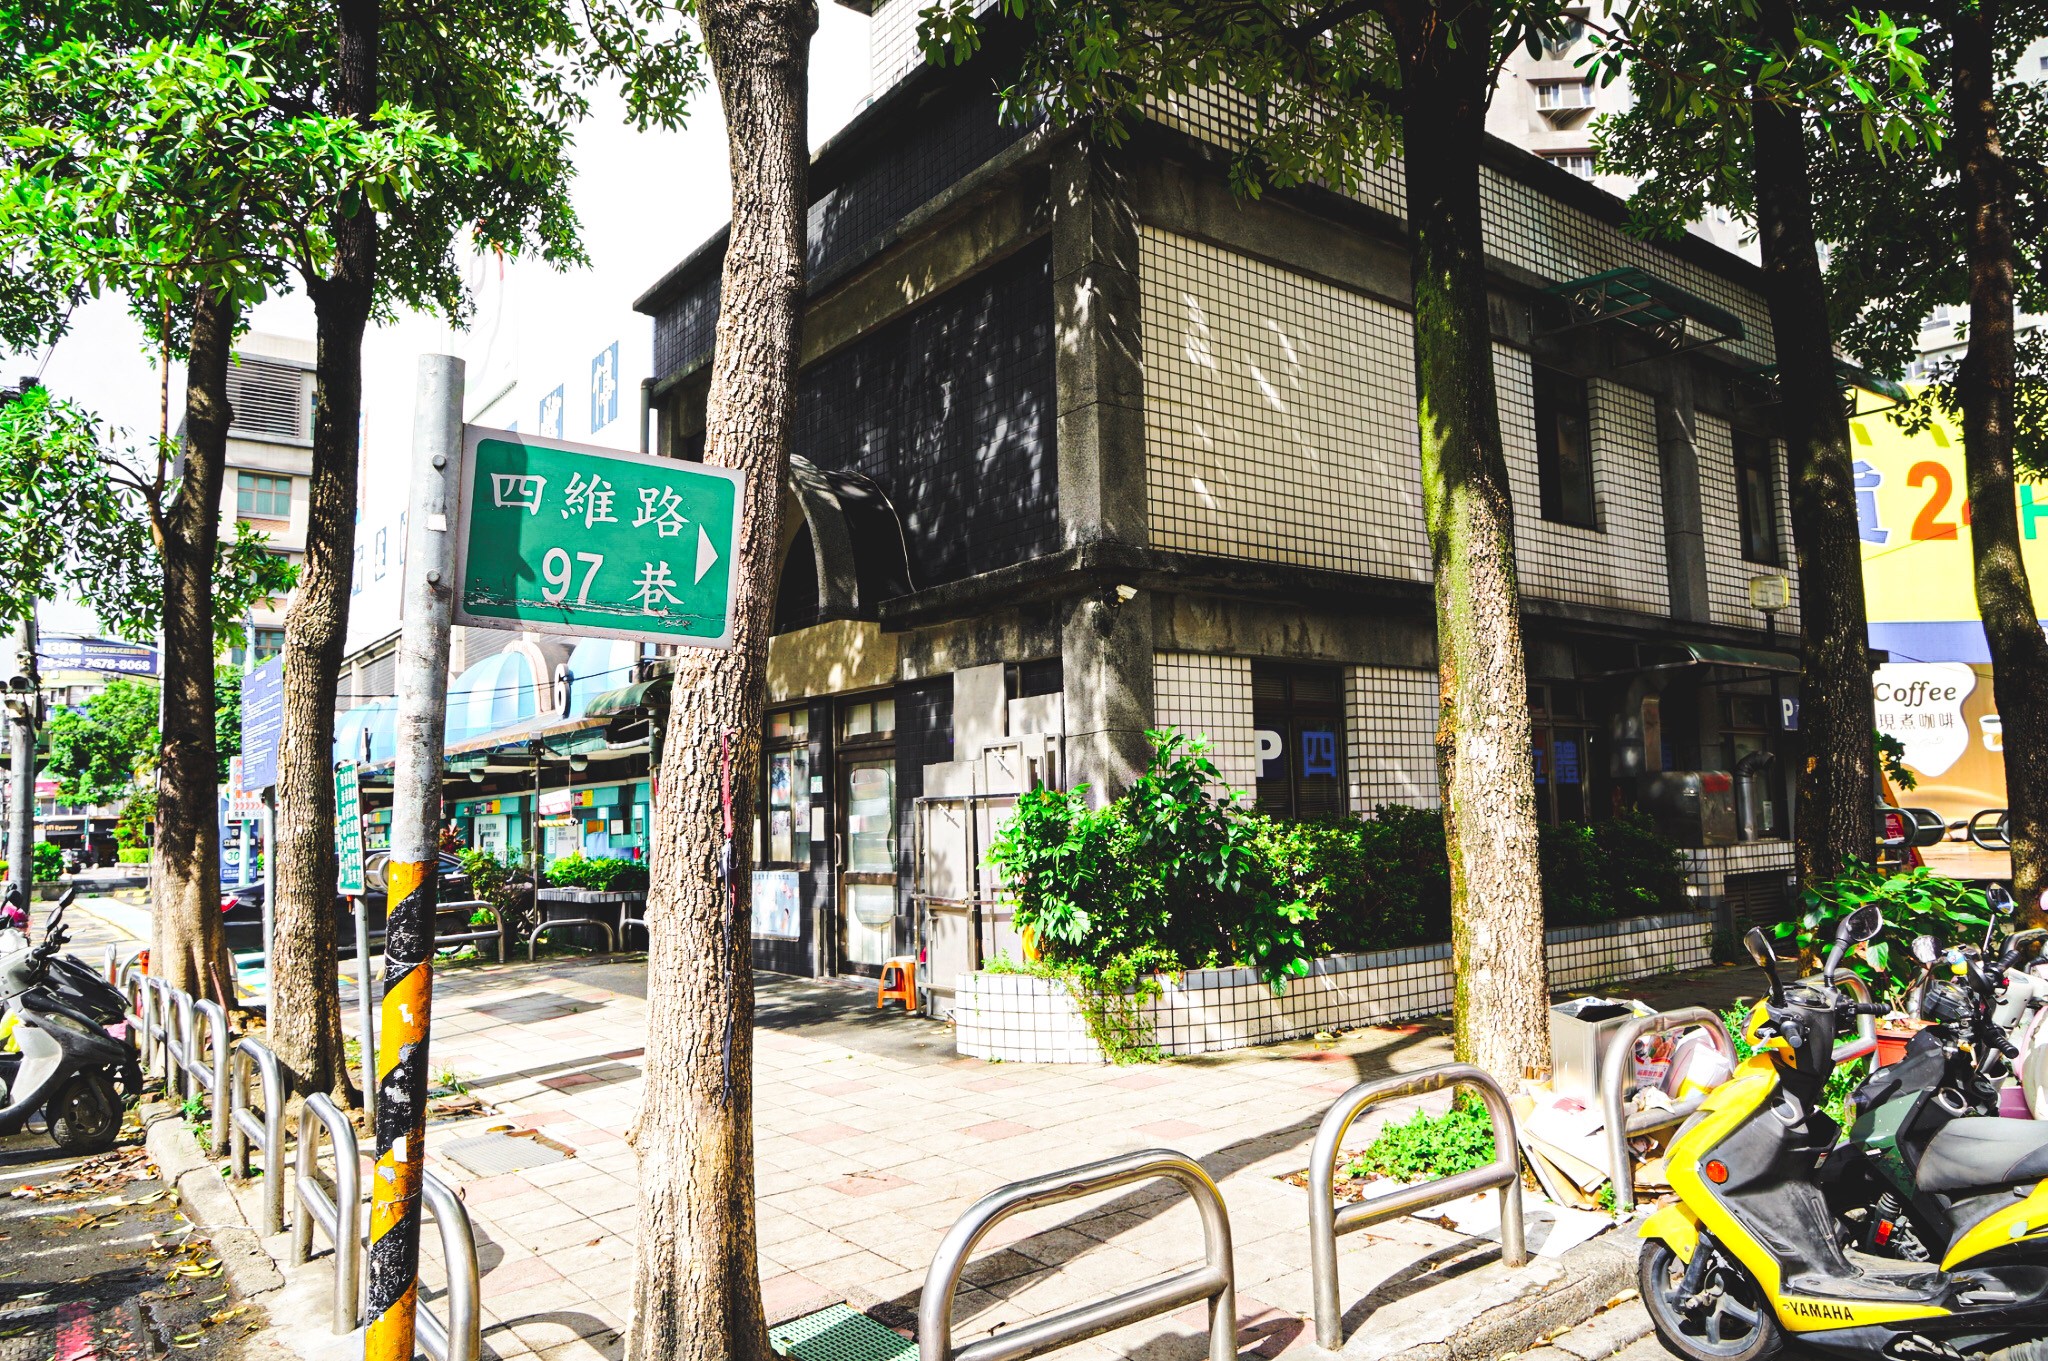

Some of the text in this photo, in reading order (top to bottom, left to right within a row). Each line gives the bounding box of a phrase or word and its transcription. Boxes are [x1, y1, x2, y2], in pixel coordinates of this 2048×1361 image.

[490, 471, 690, 538] 四維路
[84, 658, 151, 671] 2678-8068
[1874, 681, 1957, 707] Coffee
[1781, 698, 1794, 726] P
[1878, 712, 1954, 730] 現煮咖啡
[1254, 729, 1283, 778] P
[1302, 731, 1337, 778] 四
[226, 851, 240, 861] 30
[1789, 1301, 1855, 1321] YAMAHA
